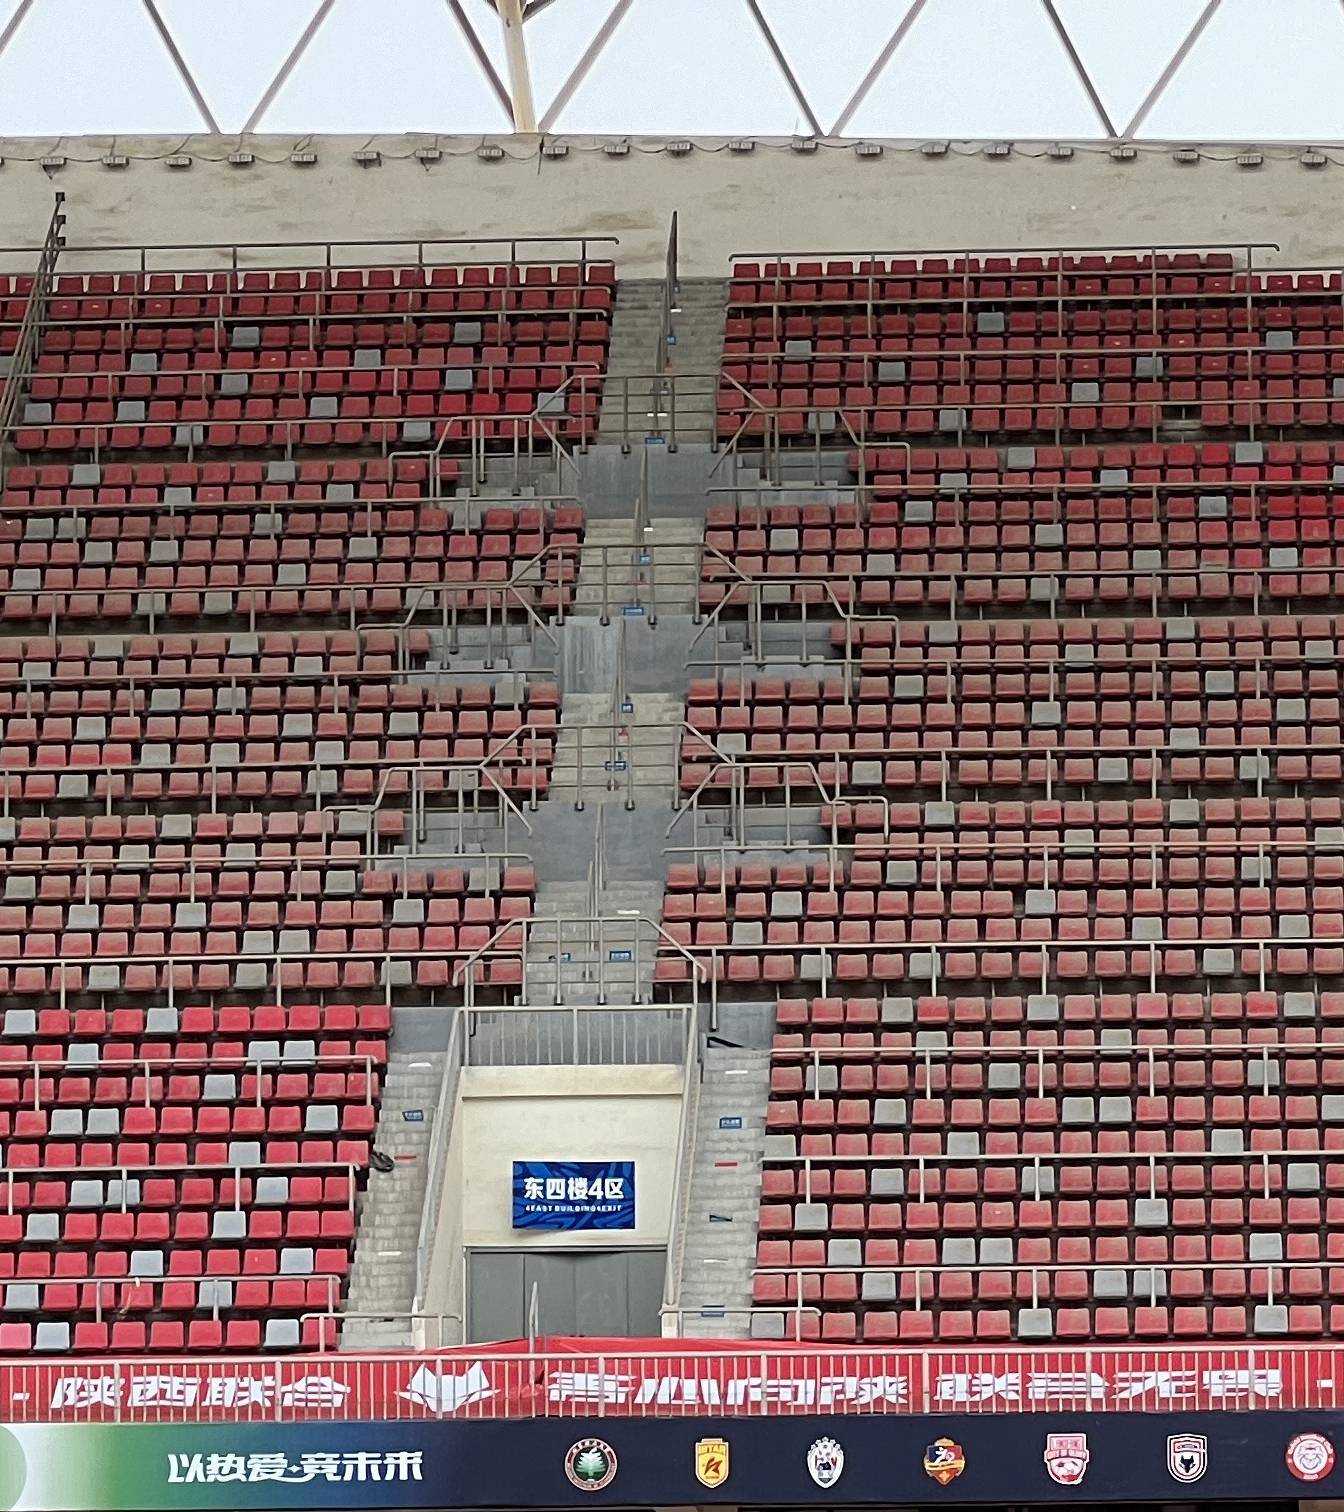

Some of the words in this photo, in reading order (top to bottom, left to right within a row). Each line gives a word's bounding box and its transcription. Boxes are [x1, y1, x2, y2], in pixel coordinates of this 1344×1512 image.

[523, 1176, 625, 1200] 东四楼4区
[50, 1375, 352, 1408] 陕西联合
[933, 1369, 1284, 1401] 联合无畏
